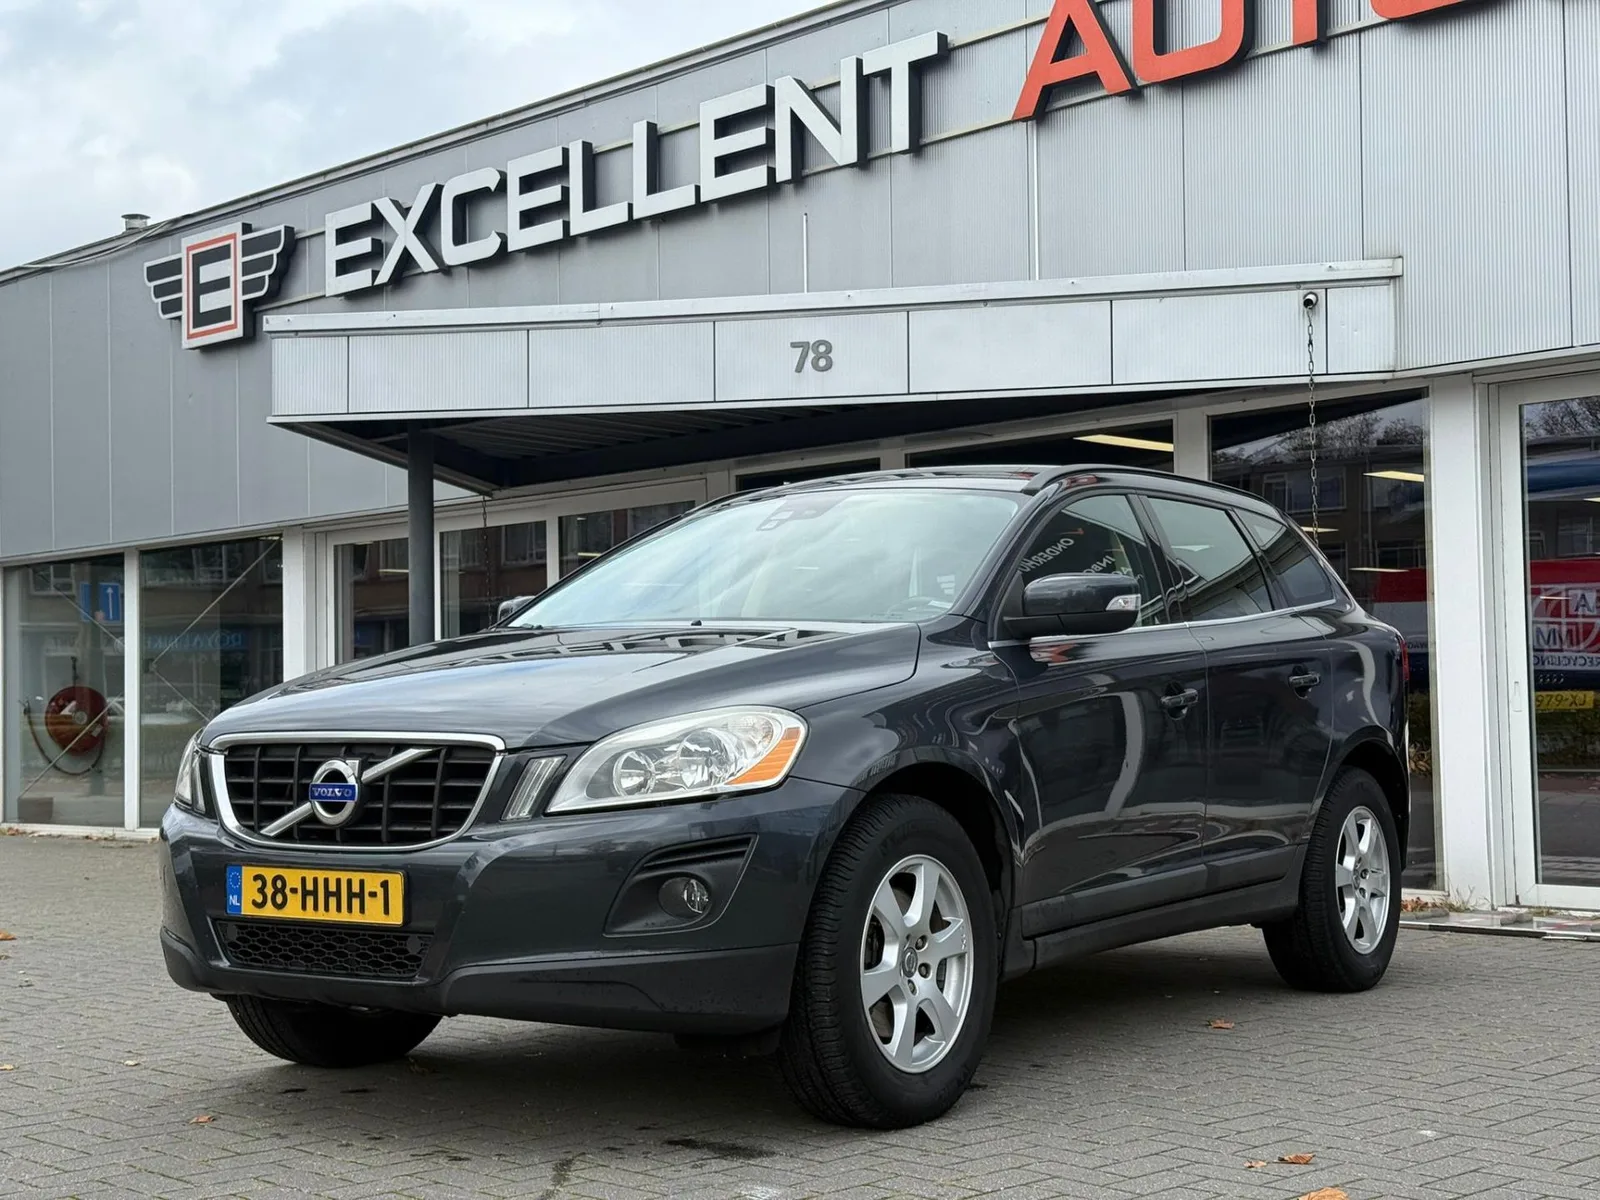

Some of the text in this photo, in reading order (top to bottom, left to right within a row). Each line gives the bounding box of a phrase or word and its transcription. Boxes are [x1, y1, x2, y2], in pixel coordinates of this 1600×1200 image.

[325, 0, 1472, 297] EXCELLENT AU
[790, 339, 833, 373] 78
[311, 787, 352, 798] VOLVO
[229, 895, 240, 906] NL
[251, 873, 390, 916] 38-HHH-1
